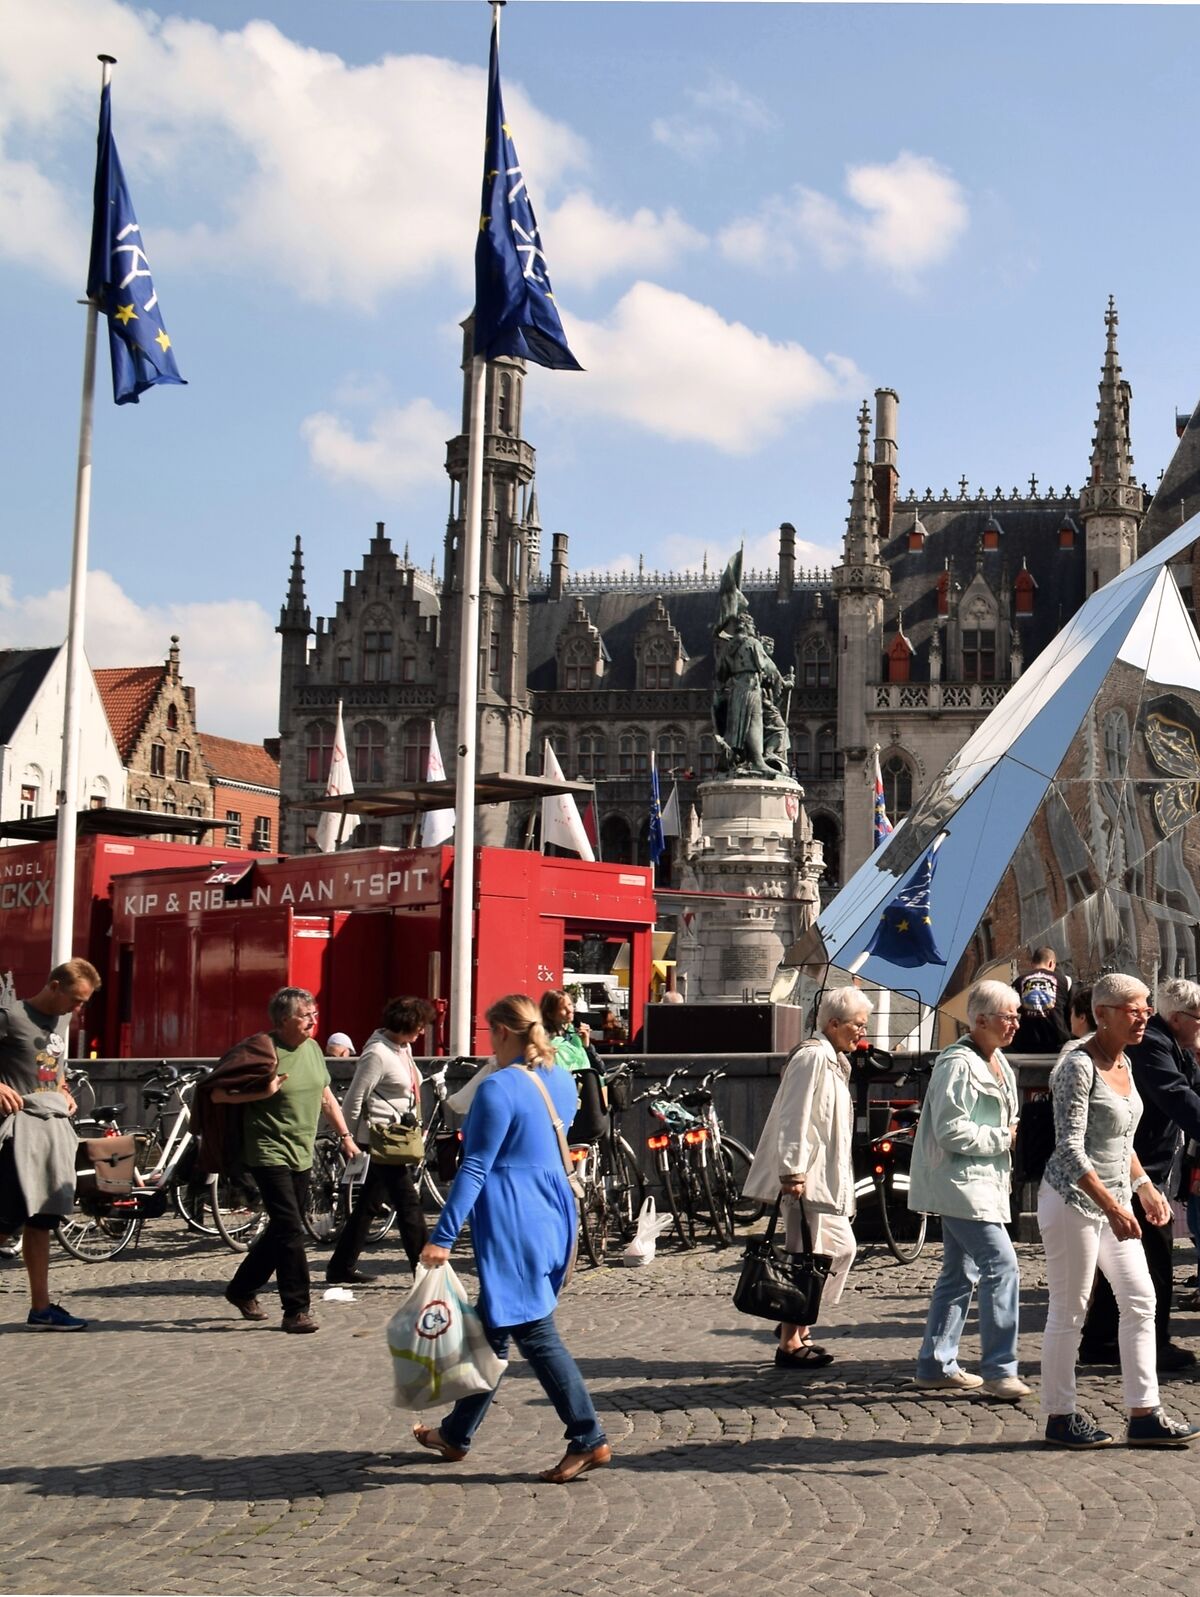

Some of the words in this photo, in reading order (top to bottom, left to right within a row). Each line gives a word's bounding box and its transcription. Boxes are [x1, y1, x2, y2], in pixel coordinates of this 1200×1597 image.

[0, 862, 43, 878] NDEL
[0, 880, 51, 909] CKX
[124, 894, 157, 915] KIP
[165, 893, 179, 912] &
[280, 879, 333, 904] AAN
